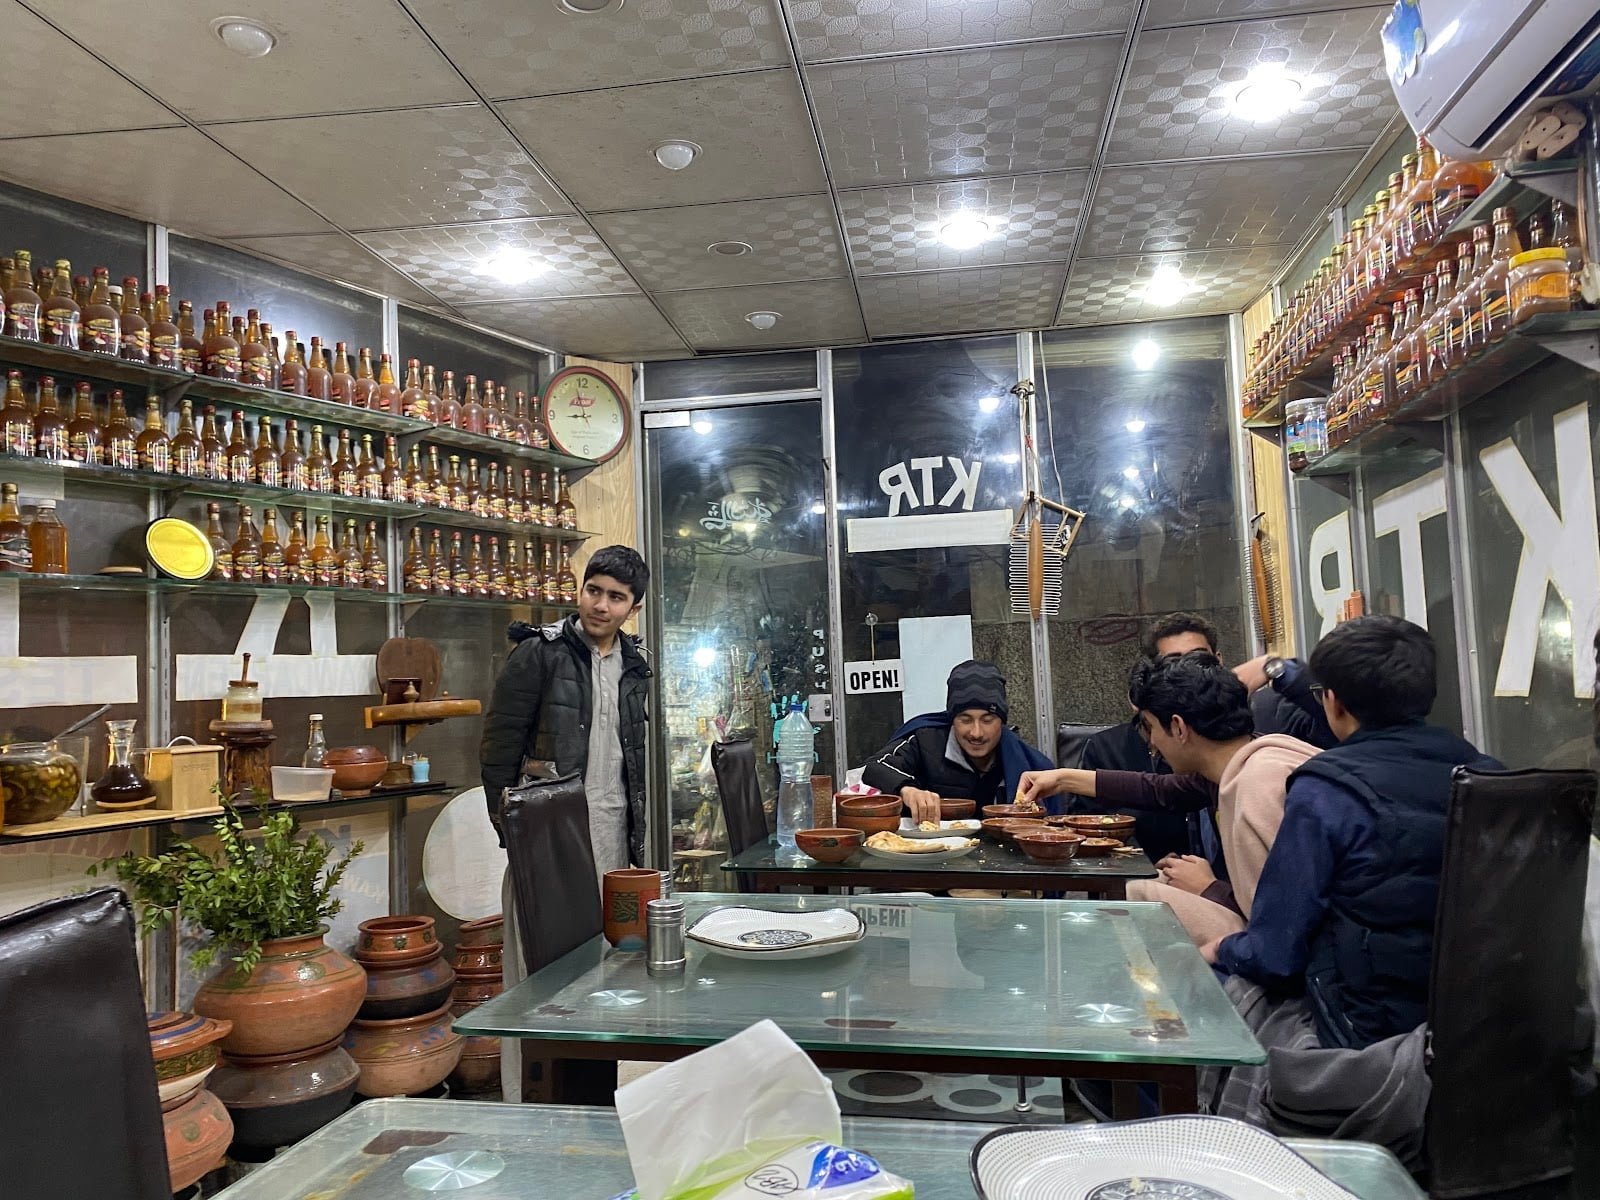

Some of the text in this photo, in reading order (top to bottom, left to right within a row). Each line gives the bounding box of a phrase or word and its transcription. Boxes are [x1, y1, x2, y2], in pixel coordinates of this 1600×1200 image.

[576, 378, 588, 388] 12
[549, 410, 556, 420] 9
[612, 414, 618, 424] 3
[583, 445, 590, 455] 6
[850, 669, 899, 691] OPEN!
